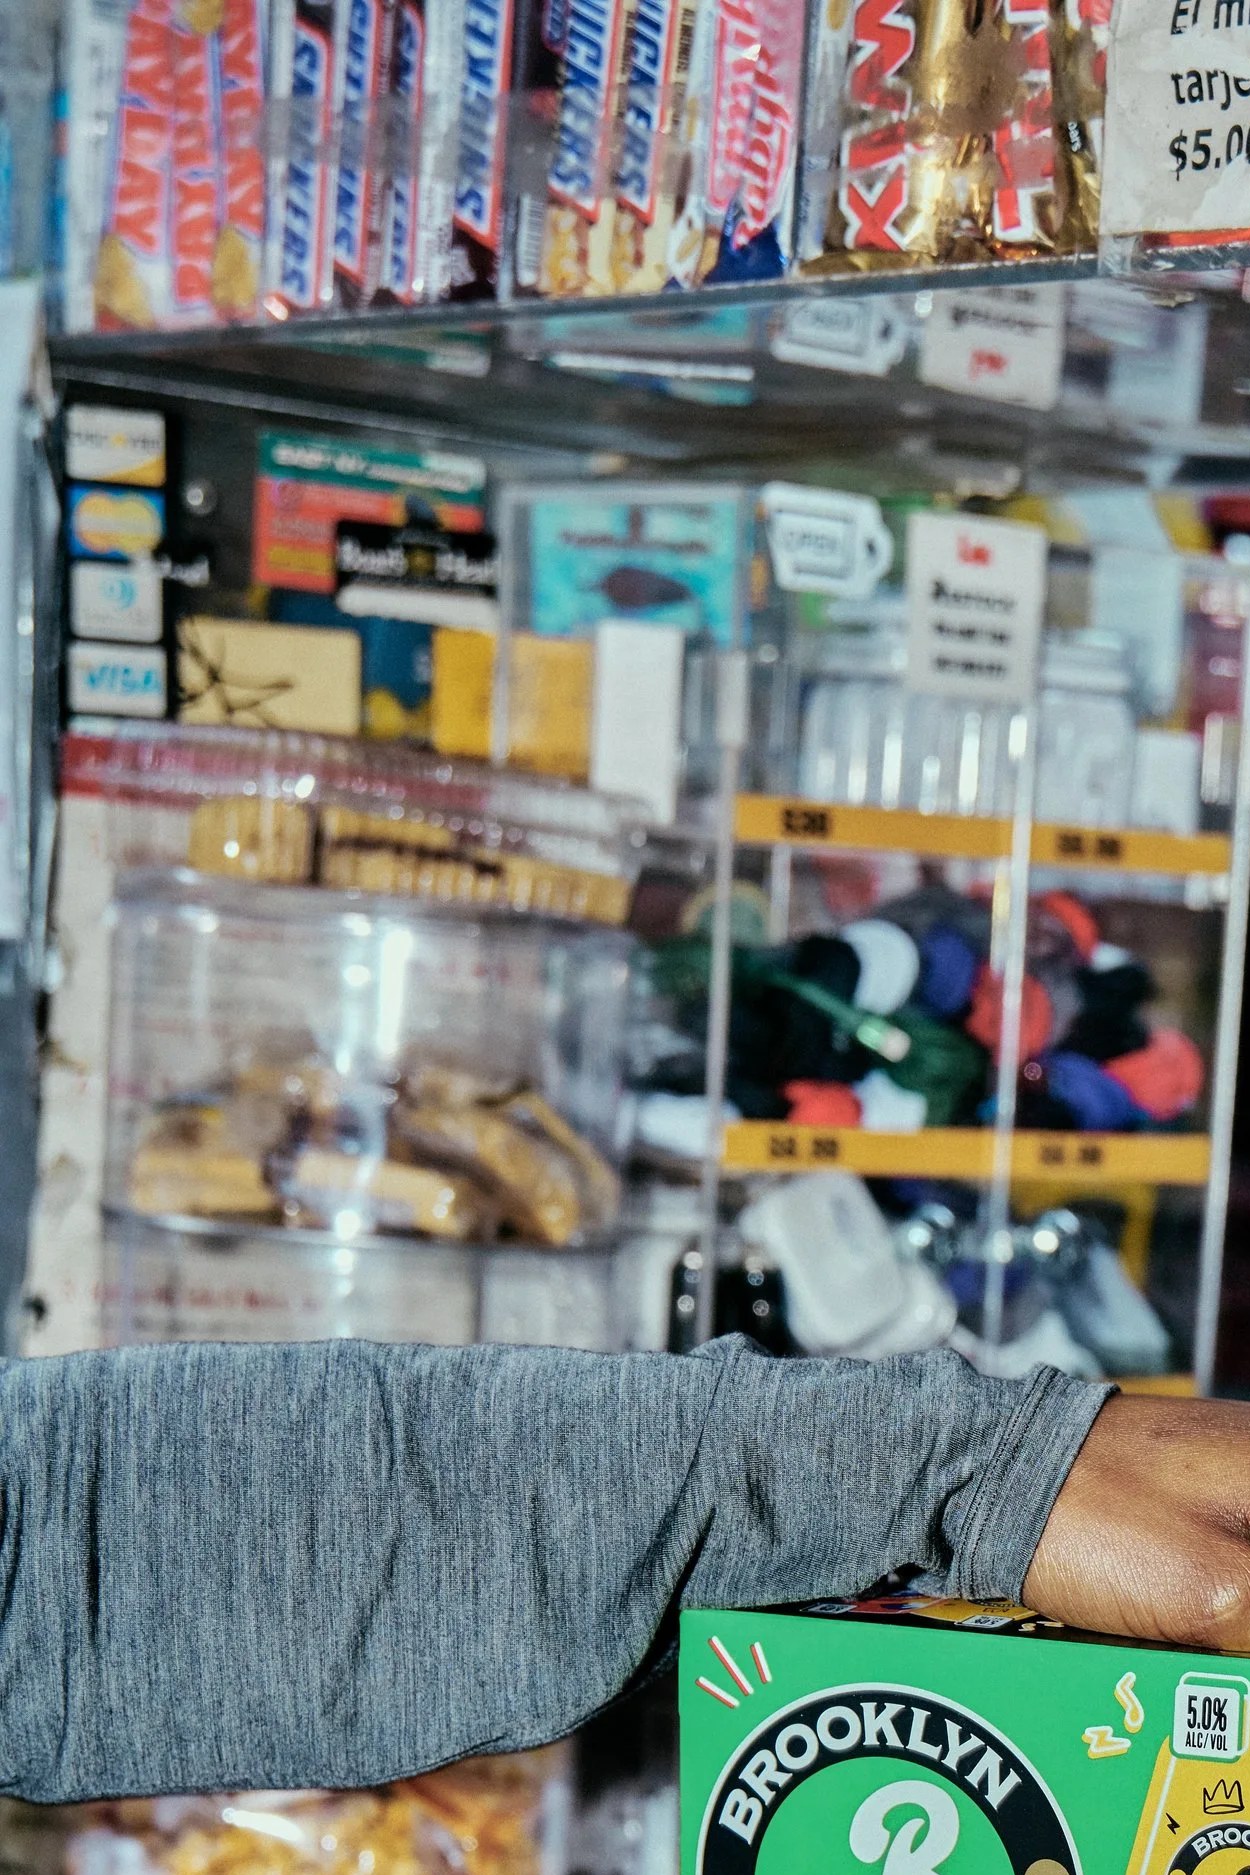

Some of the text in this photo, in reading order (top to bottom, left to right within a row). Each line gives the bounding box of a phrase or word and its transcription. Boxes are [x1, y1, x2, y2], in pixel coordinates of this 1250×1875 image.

[840, 0, 917, 251] WIX
[1185, 1731, 1229, 1753] ALC/VOL
[1186, 1694, 1228, 1735] 5.0%
[718, 1702, 1022, 1846] BROOKLYN
